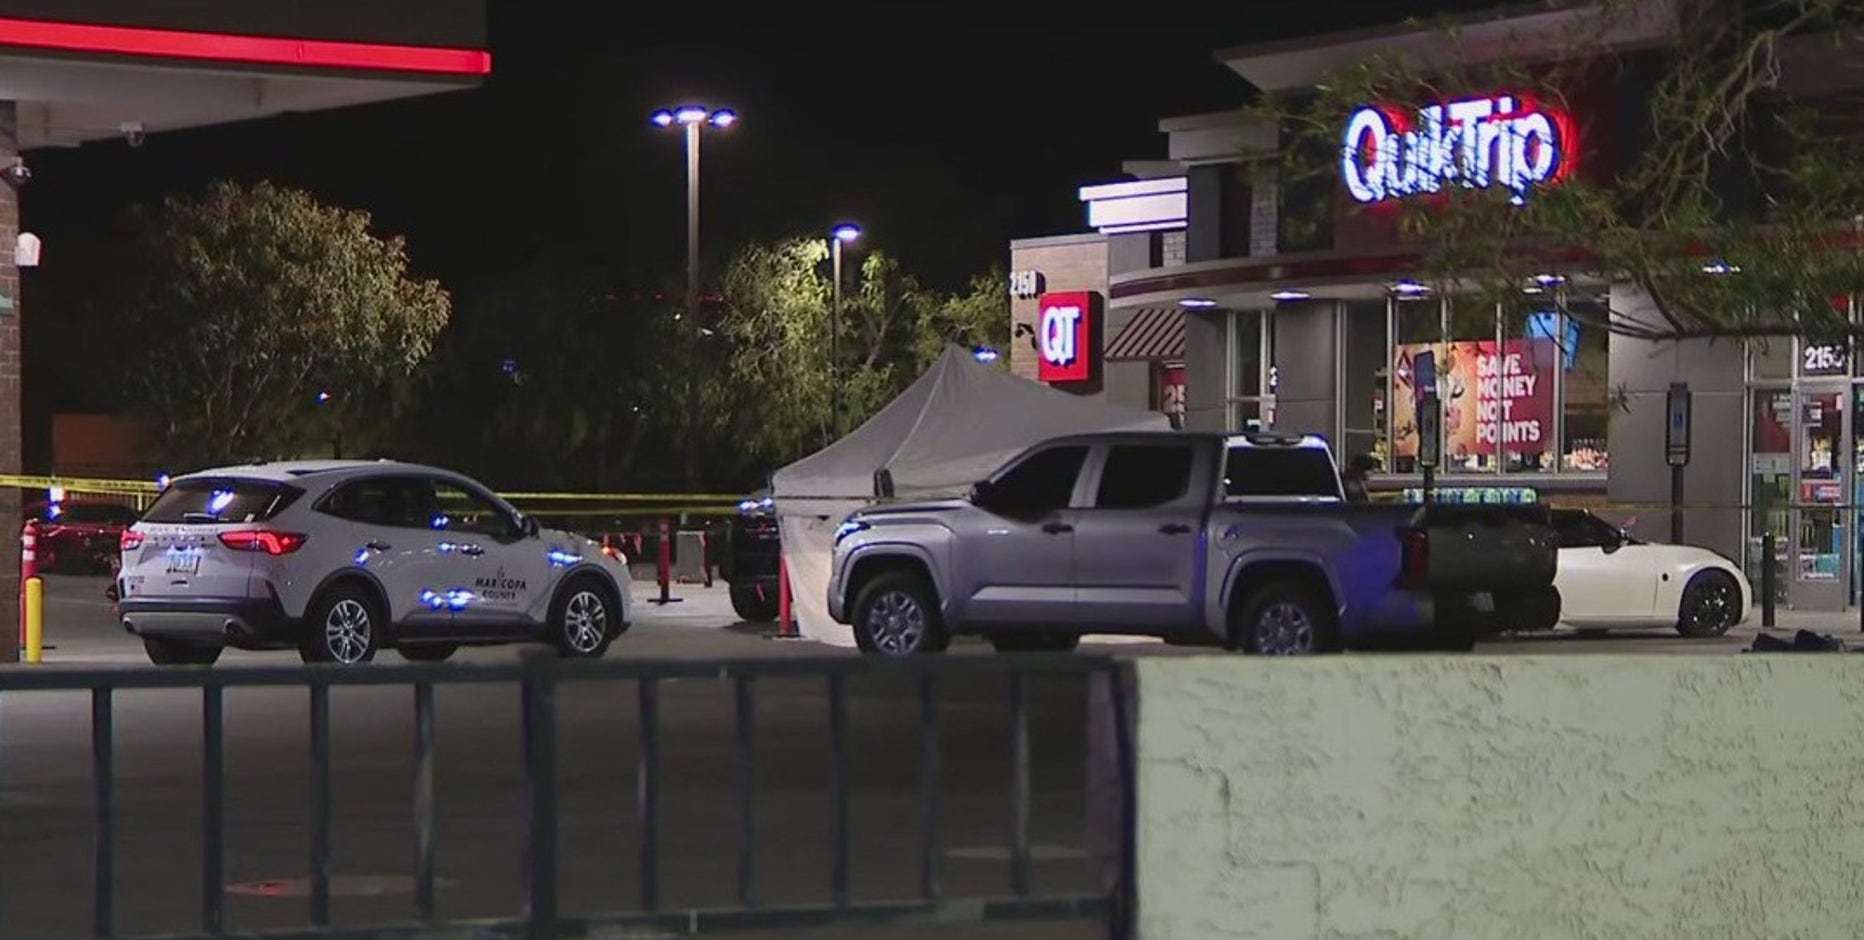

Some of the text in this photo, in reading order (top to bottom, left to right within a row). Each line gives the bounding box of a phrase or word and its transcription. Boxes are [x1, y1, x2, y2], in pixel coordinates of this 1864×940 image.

[1344, 96, 1554, 204] QuikTrip
[1042, 306, 1081, 365] QT
[1477, 353, 1521, 376] SAVE
[1477, 375, 1536, 398] MONEY
[1477, 399, 1513, 421] NOT
[1476, 420, 1540, 443] POINTS
[475, 577, 527, 591] MARICOPA
